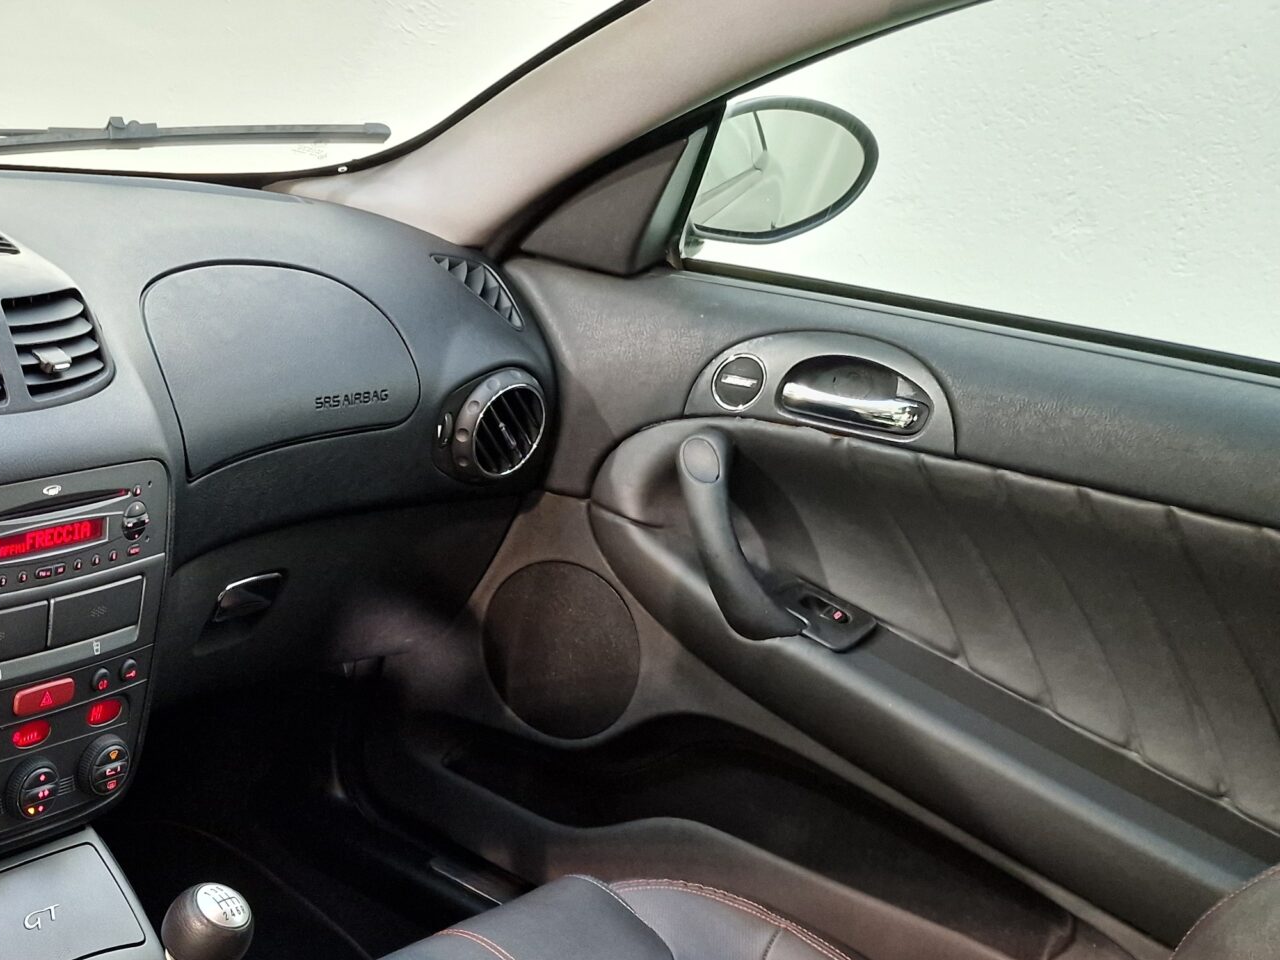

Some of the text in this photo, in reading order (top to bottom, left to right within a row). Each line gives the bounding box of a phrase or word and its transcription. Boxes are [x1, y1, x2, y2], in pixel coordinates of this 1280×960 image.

[315, 389, 389, 409] SRS AIRBAG
[26, 521, 91, 551] FRECCIA
[23, 903, 61, 931] GT
[222, 911, 230, 921] 2
